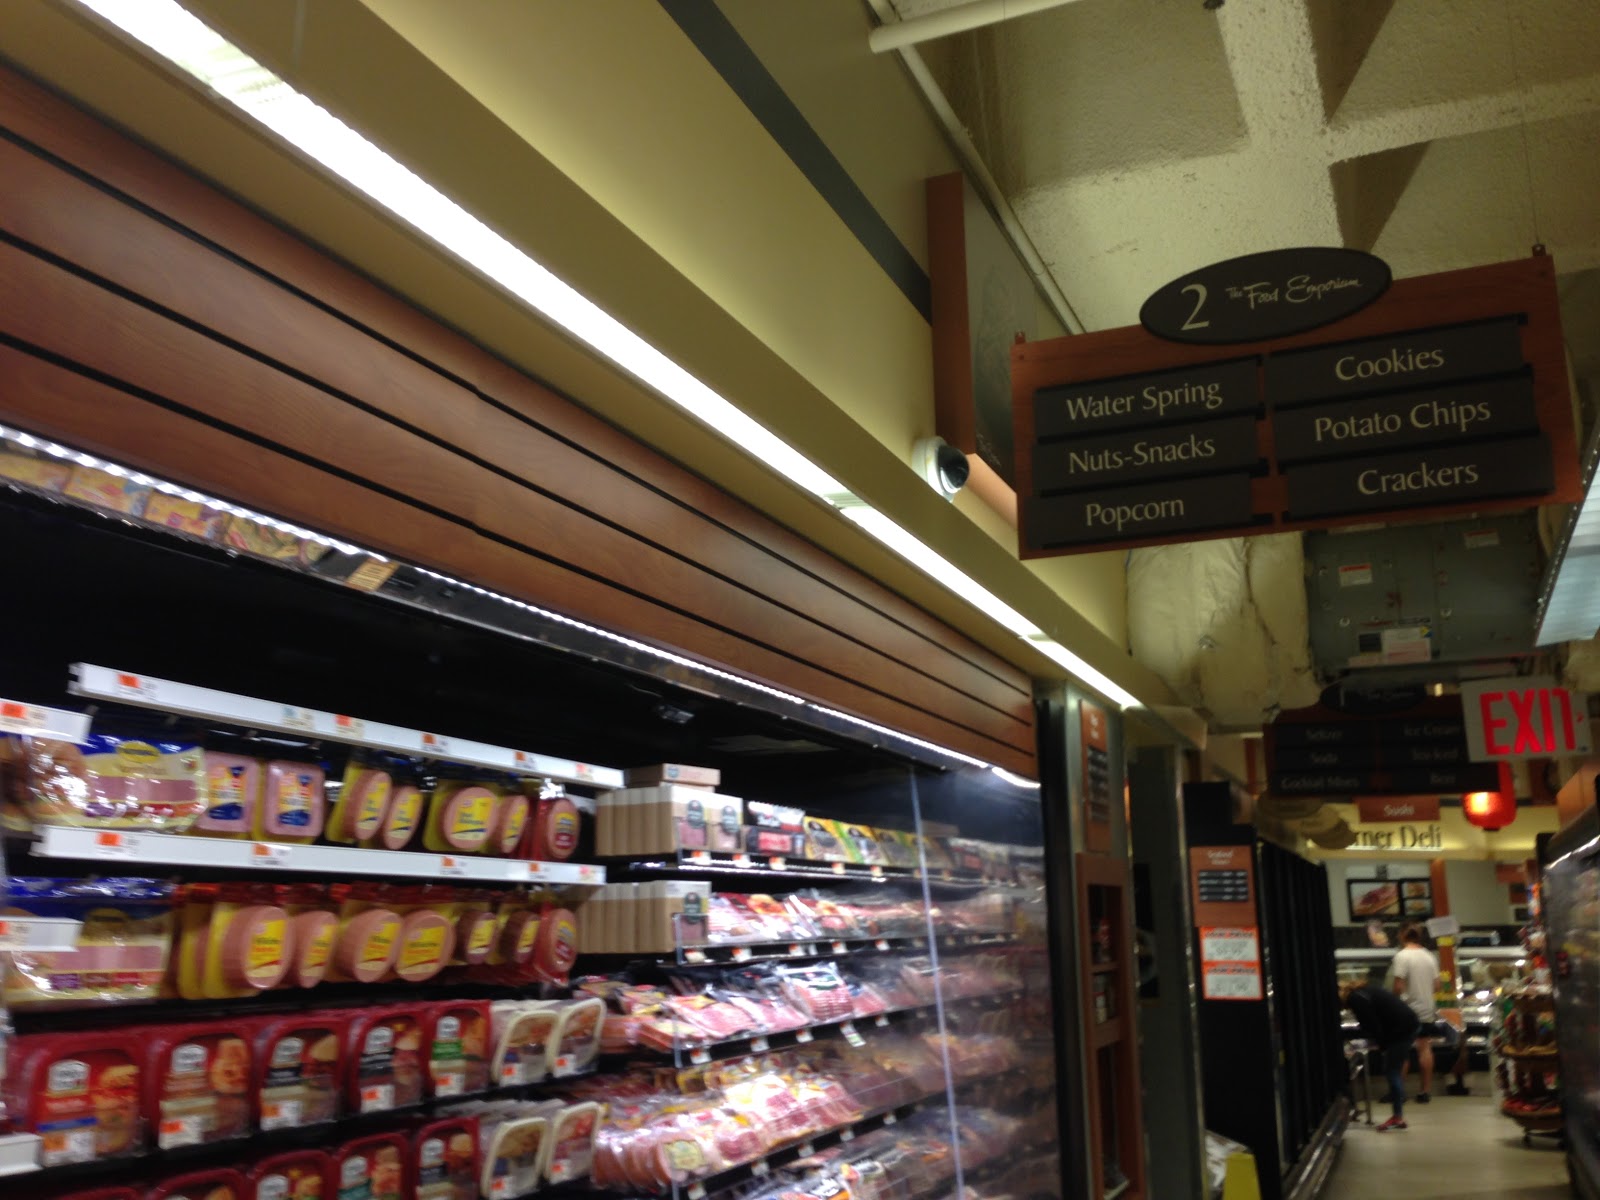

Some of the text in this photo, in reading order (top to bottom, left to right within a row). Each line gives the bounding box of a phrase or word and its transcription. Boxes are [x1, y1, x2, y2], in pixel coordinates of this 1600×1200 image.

[1180, 283, 1210, 331] 2
[1225, 275, 1364, 310] The Food Emporium
[1335, 346, 1445, 382] Cookies
[1066, 379, 1223, 421] Water Spring
[1314, 398, 1492, 442] Potato Chips
[1068, 435, 1217, 475] Nuts-Snacks
[1357, 462, 1479, 496] Crackers
[1085, 497, 1185, 532] Popcorn
[1479, 687, 1576, 756] EXIT
[1400, 824, 1442, 849] Deli
